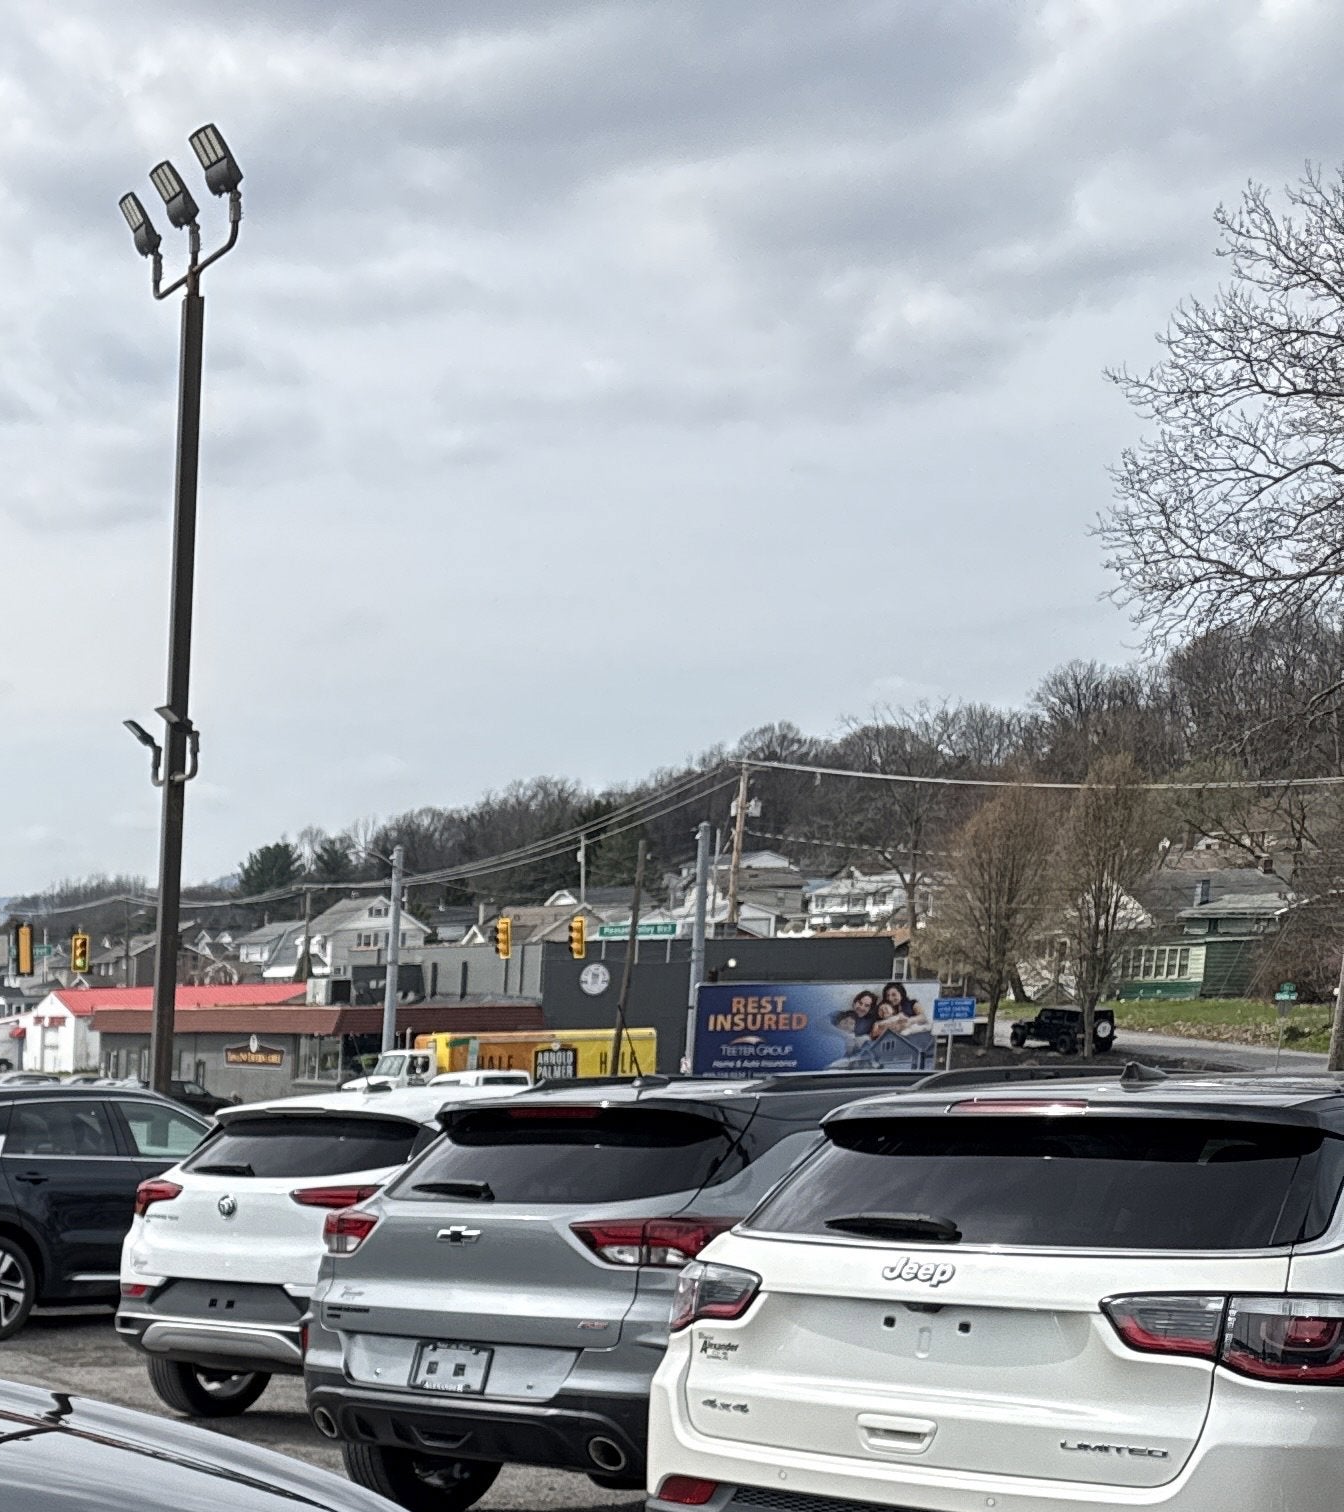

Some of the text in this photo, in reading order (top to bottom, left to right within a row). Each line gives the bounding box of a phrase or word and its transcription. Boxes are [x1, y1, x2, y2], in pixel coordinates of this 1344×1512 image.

[732, 996, 787, 1014] REST
[708, 1013, 808, 1032] INSURED
[537, 1051, 574, 1065] ARNOLD
[756, 1044, 793, 1056] GROUP
[599, 1052, 637, 1073] HLF
[537, 1065, 574, 1079] PALMER
[882, 1256, 957, 1288] Jeep
[700, 1340, 740, 1354] Alexander
[702, 1399, 750, 1414] 4x4
[1060, 1439, 1168, 1458] LIMITED
